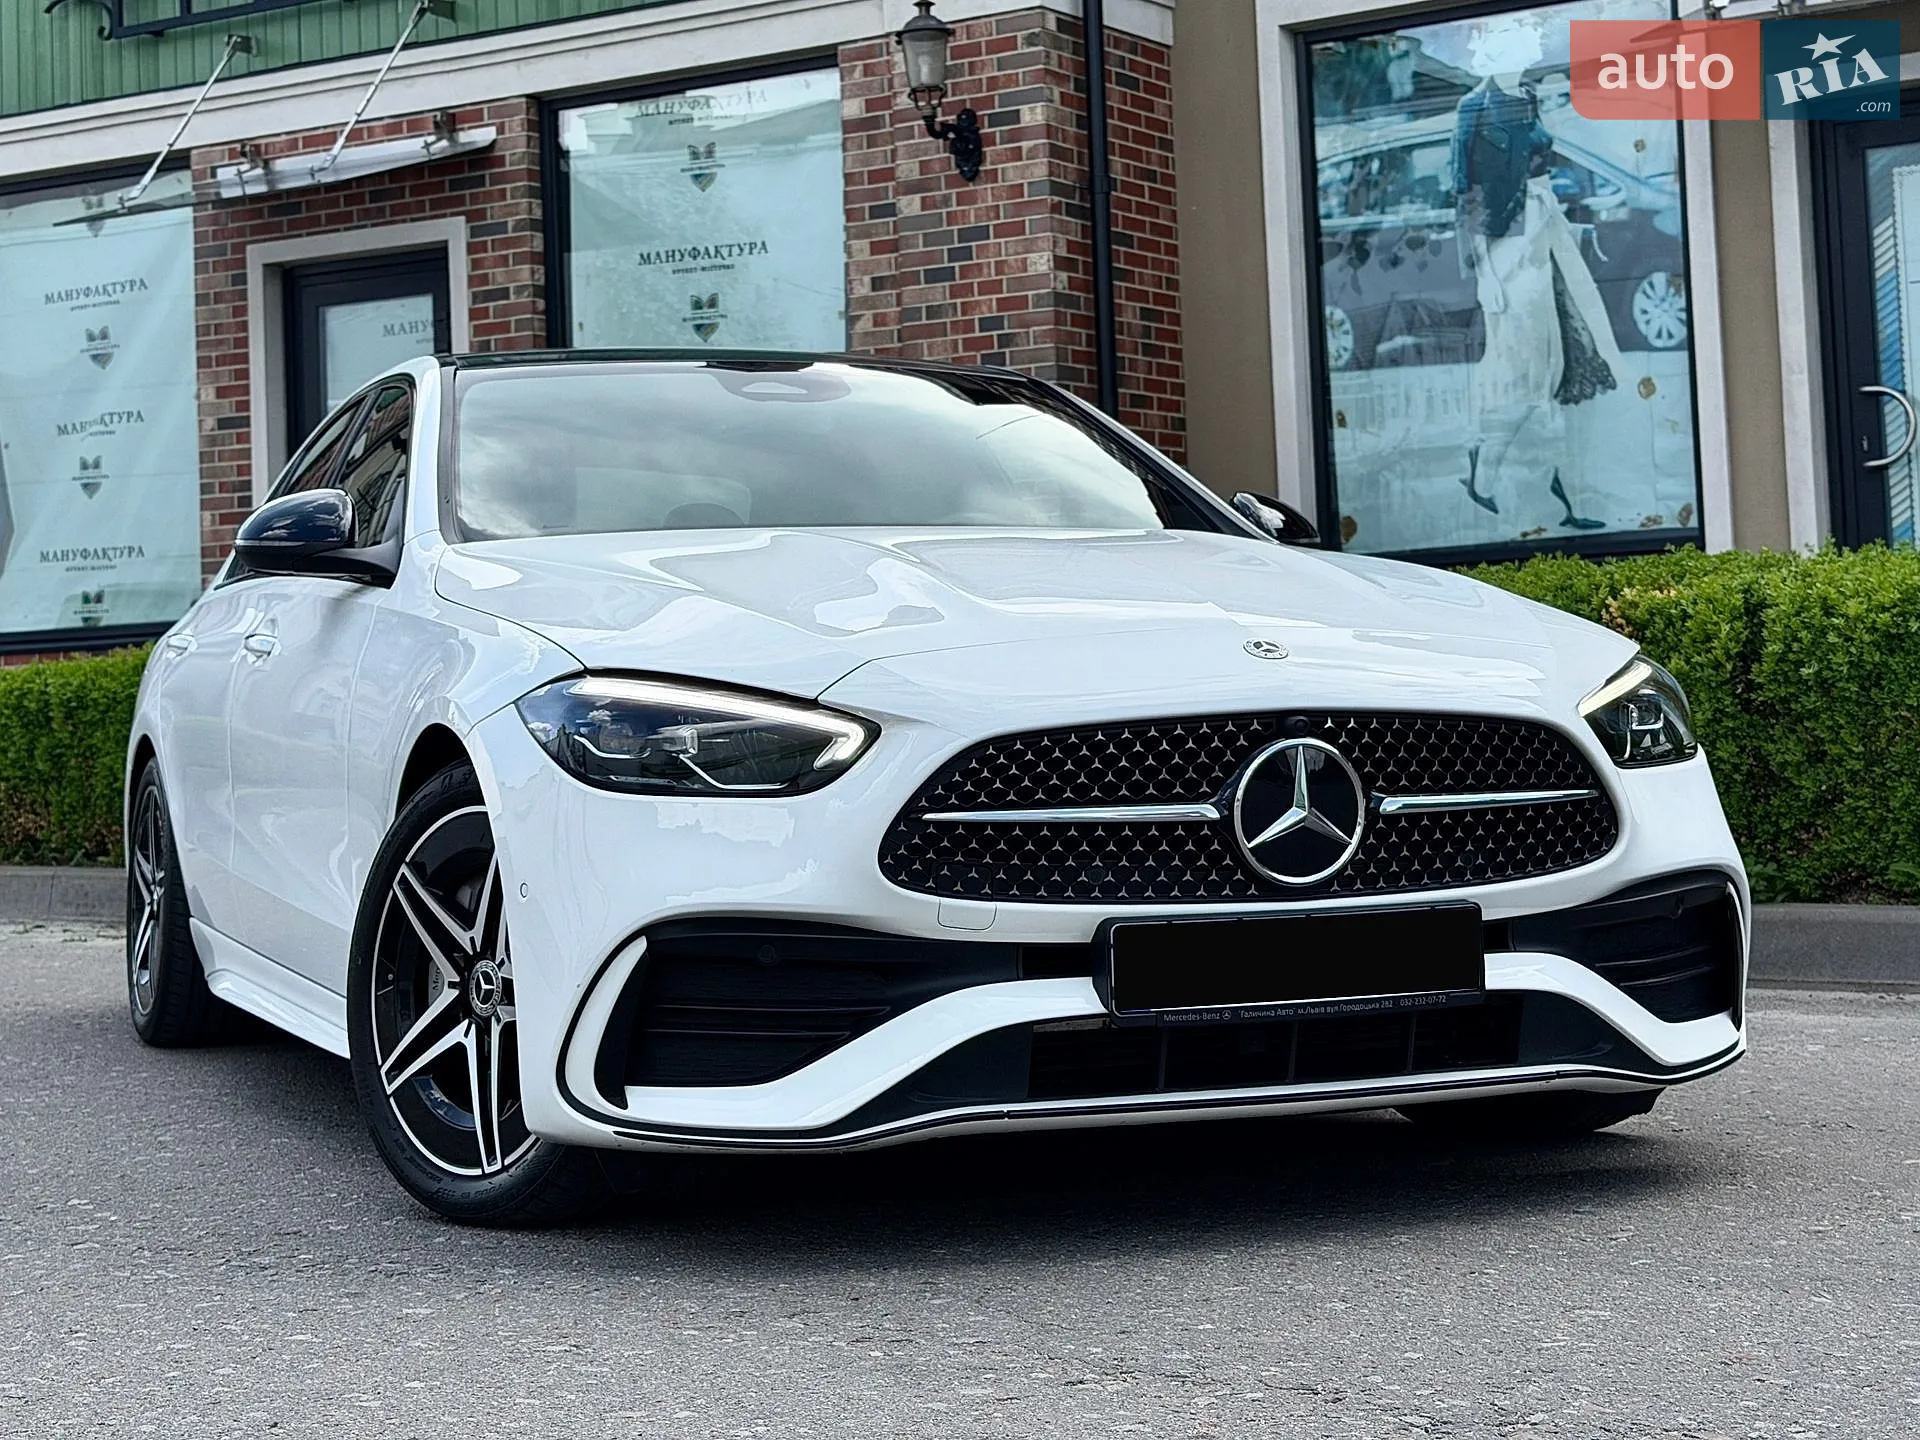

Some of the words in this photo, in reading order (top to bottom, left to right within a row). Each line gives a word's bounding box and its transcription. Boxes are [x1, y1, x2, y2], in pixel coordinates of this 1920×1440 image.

[637, 240, 769, 266] МАНУФАКТУРА
[44, 278, 149, 305] МАНУФАКТУРА
[382, 319, 433, 338] МАНУ
[40, 545, 145, 563] МАНУФАКТУРА
[1163, 1011, 1220, 1022] Mercedes-Benz
